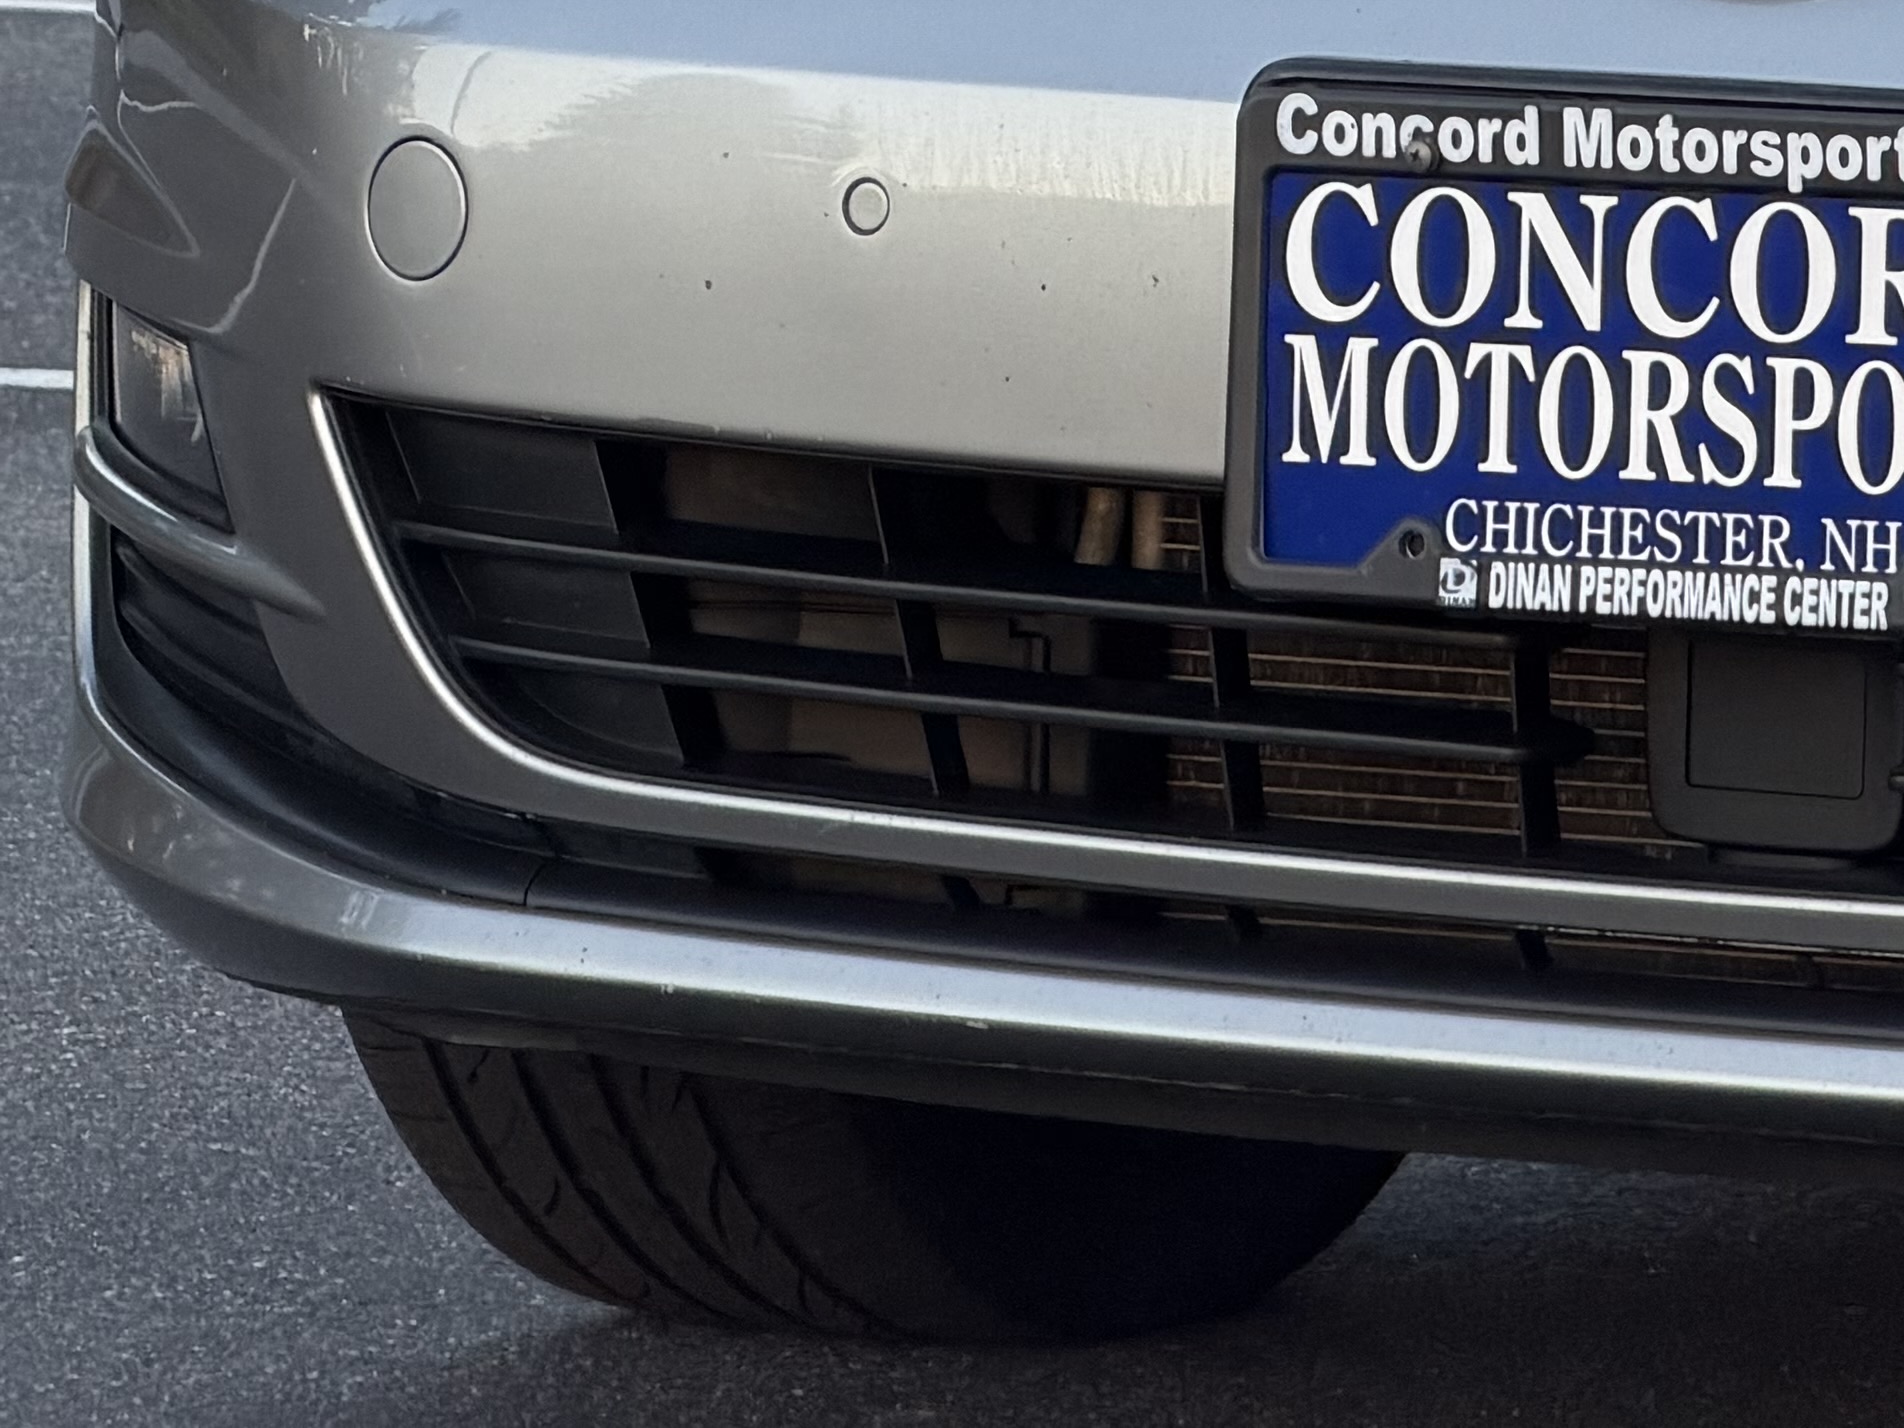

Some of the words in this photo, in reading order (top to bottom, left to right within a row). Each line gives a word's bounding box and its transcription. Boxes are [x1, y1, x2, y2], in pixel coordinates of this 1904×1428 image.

[1275, 91, 1541, 167] Concord
[1820, 517, 1903, 575] NH
[1488, 560, 1573, 613] DINAN
[1578, 565, 1778, 626] PERFORMANCE
[1783, 575, 1890, 632] CENTER
